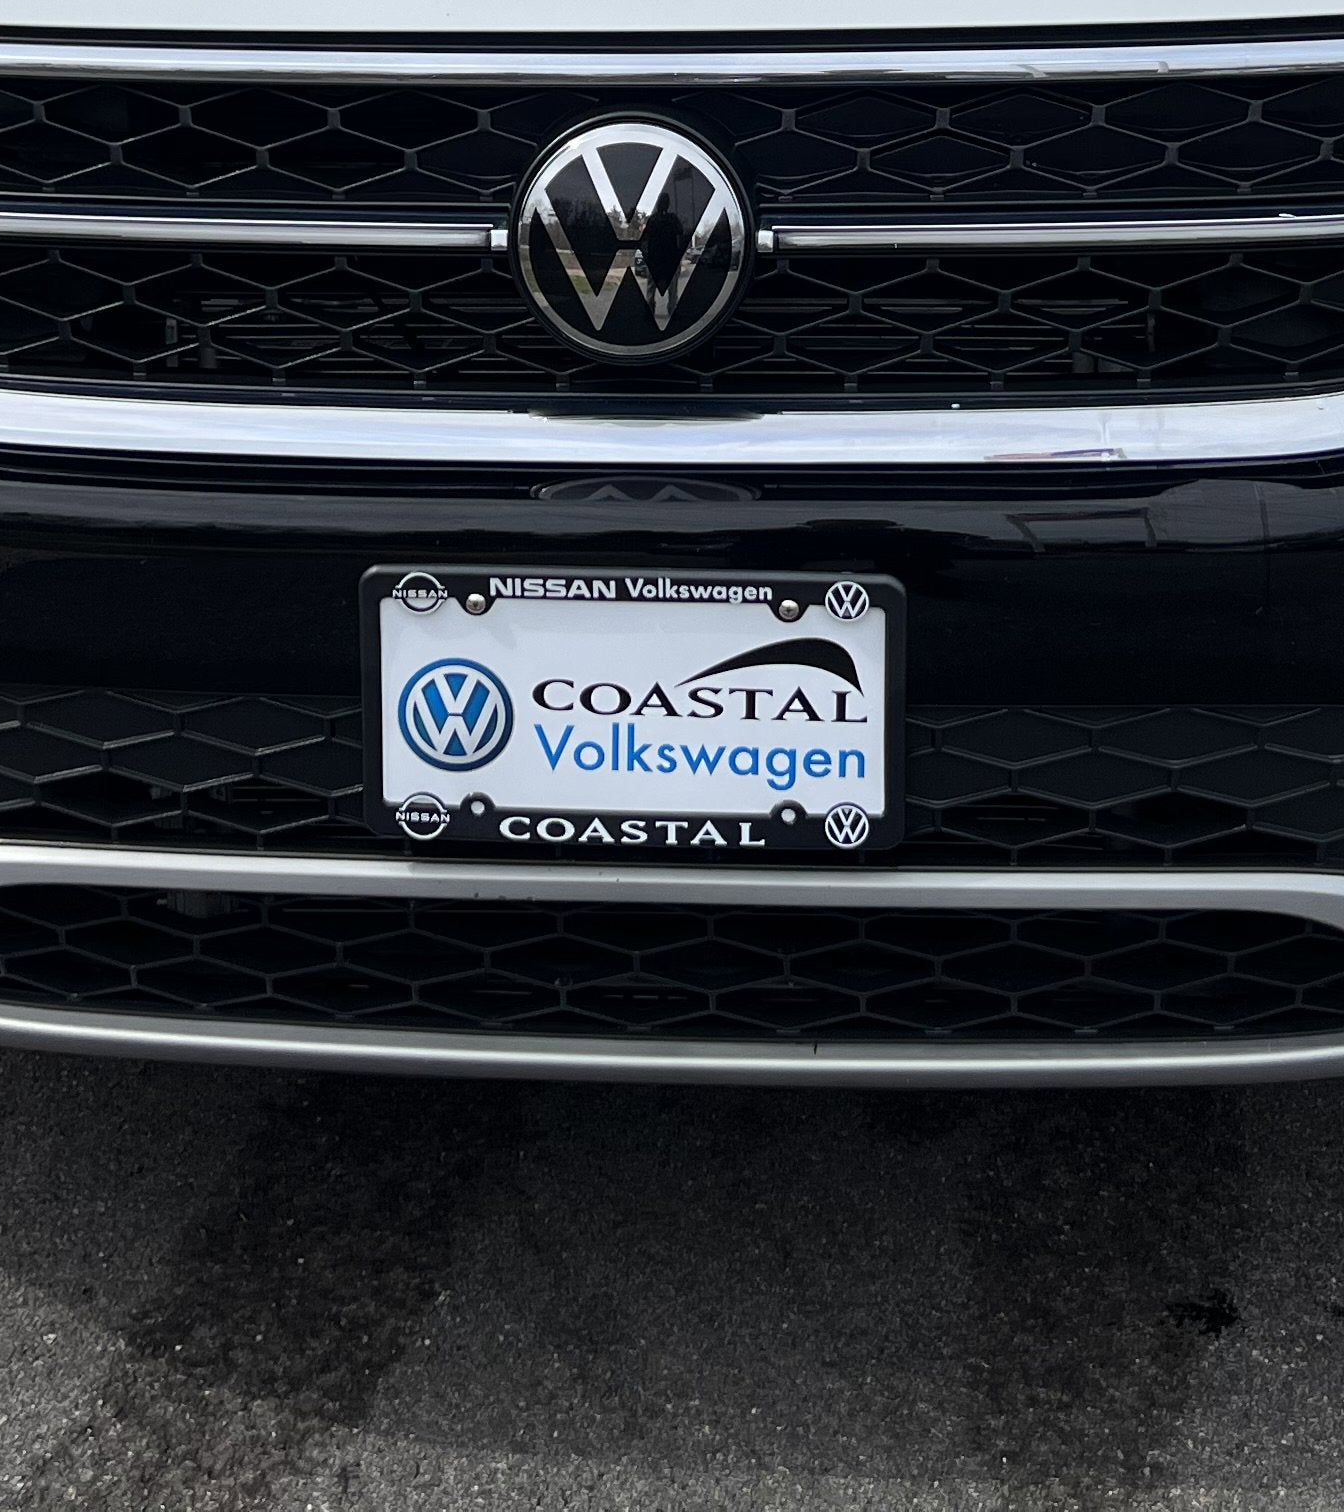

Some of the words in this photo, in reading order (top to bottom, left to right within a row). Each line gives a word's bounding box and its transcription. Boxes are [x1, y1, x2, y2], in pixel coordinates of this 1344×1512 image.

[392, 589, 448, 599] NISSAN
[489, 576, 617, 600] NISSAN
[624, 577, 773, 604] Volkswagen
[532, 678, 868, 723] COASTAL
[534, 722, 865, 791] Volkswagen
[395, 811, 451, 824] NISSAN
[498, 815, 766, 847] COASTAL
